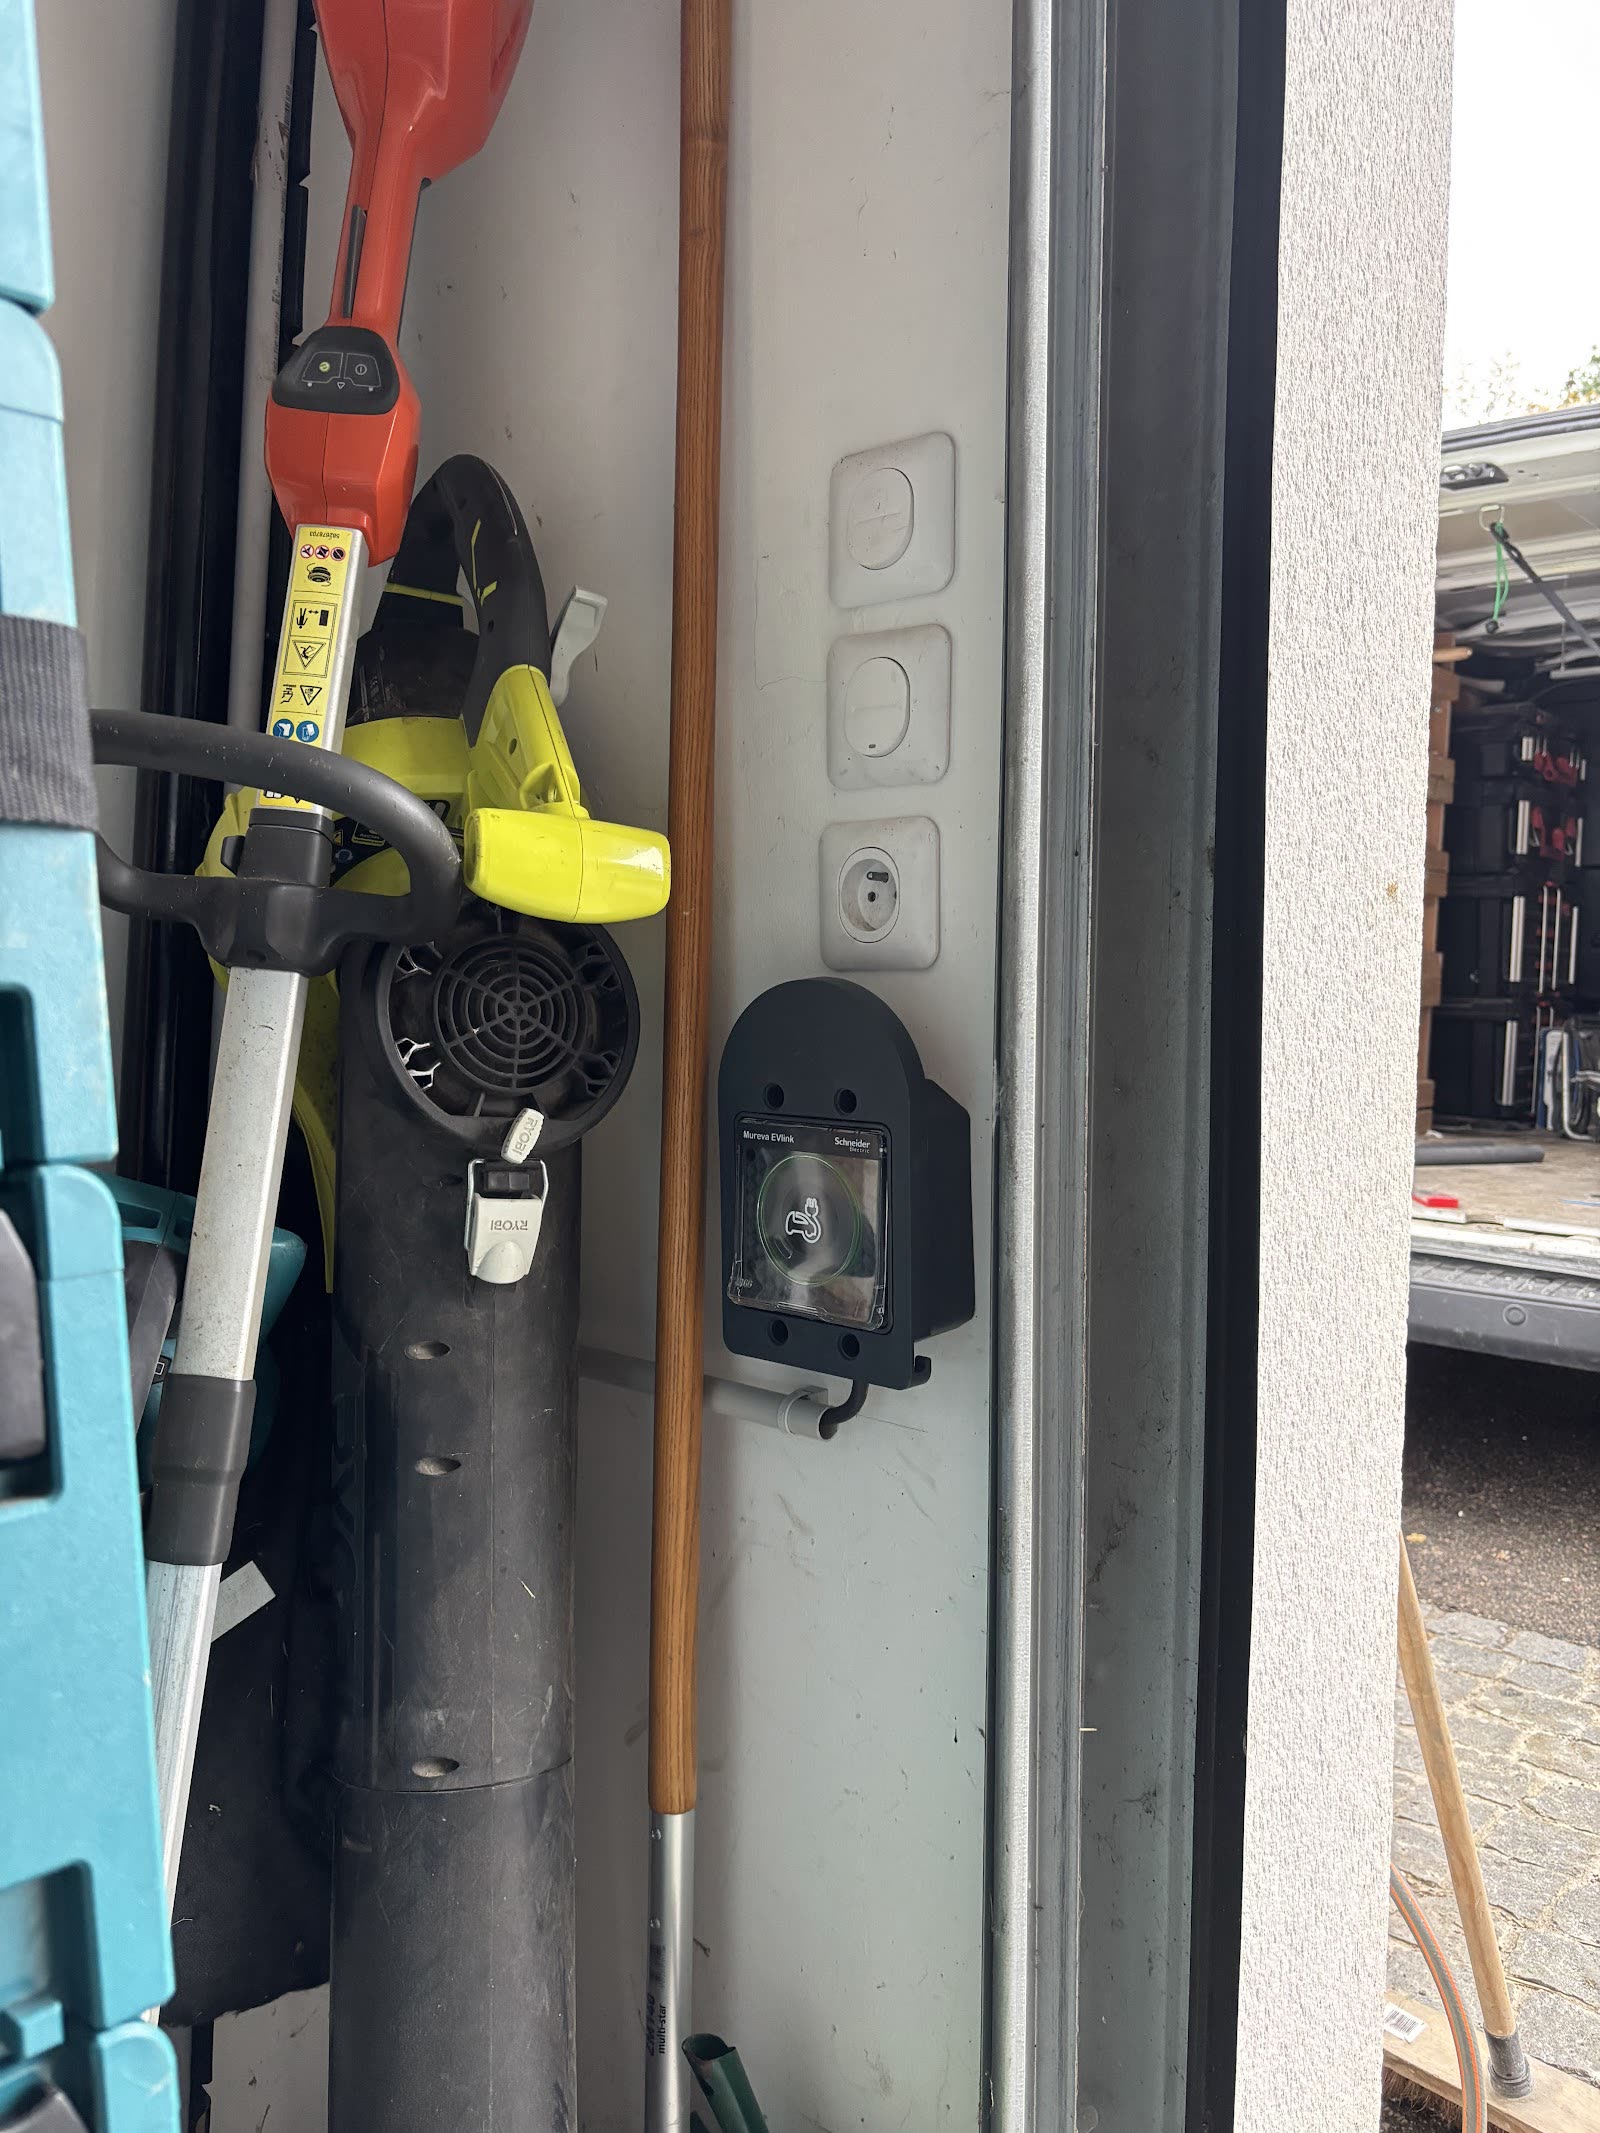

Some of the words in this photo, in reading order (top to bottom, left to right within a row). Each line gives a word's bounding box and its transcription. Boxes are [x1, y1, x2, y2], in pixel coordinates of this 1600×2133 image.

[512, 1117, 538, 1155] RYOBI
[743, 1130, 770, 1142] Mureva
[771, 1132, 795, 1144] EVlink
[834, 1136, 870, 1149] Schneider
[849, 1146, 870, 1154] Electric
[490, 1219, 529, 1231] RYOBI
[656, 2003, 666, 2054] multi-star
